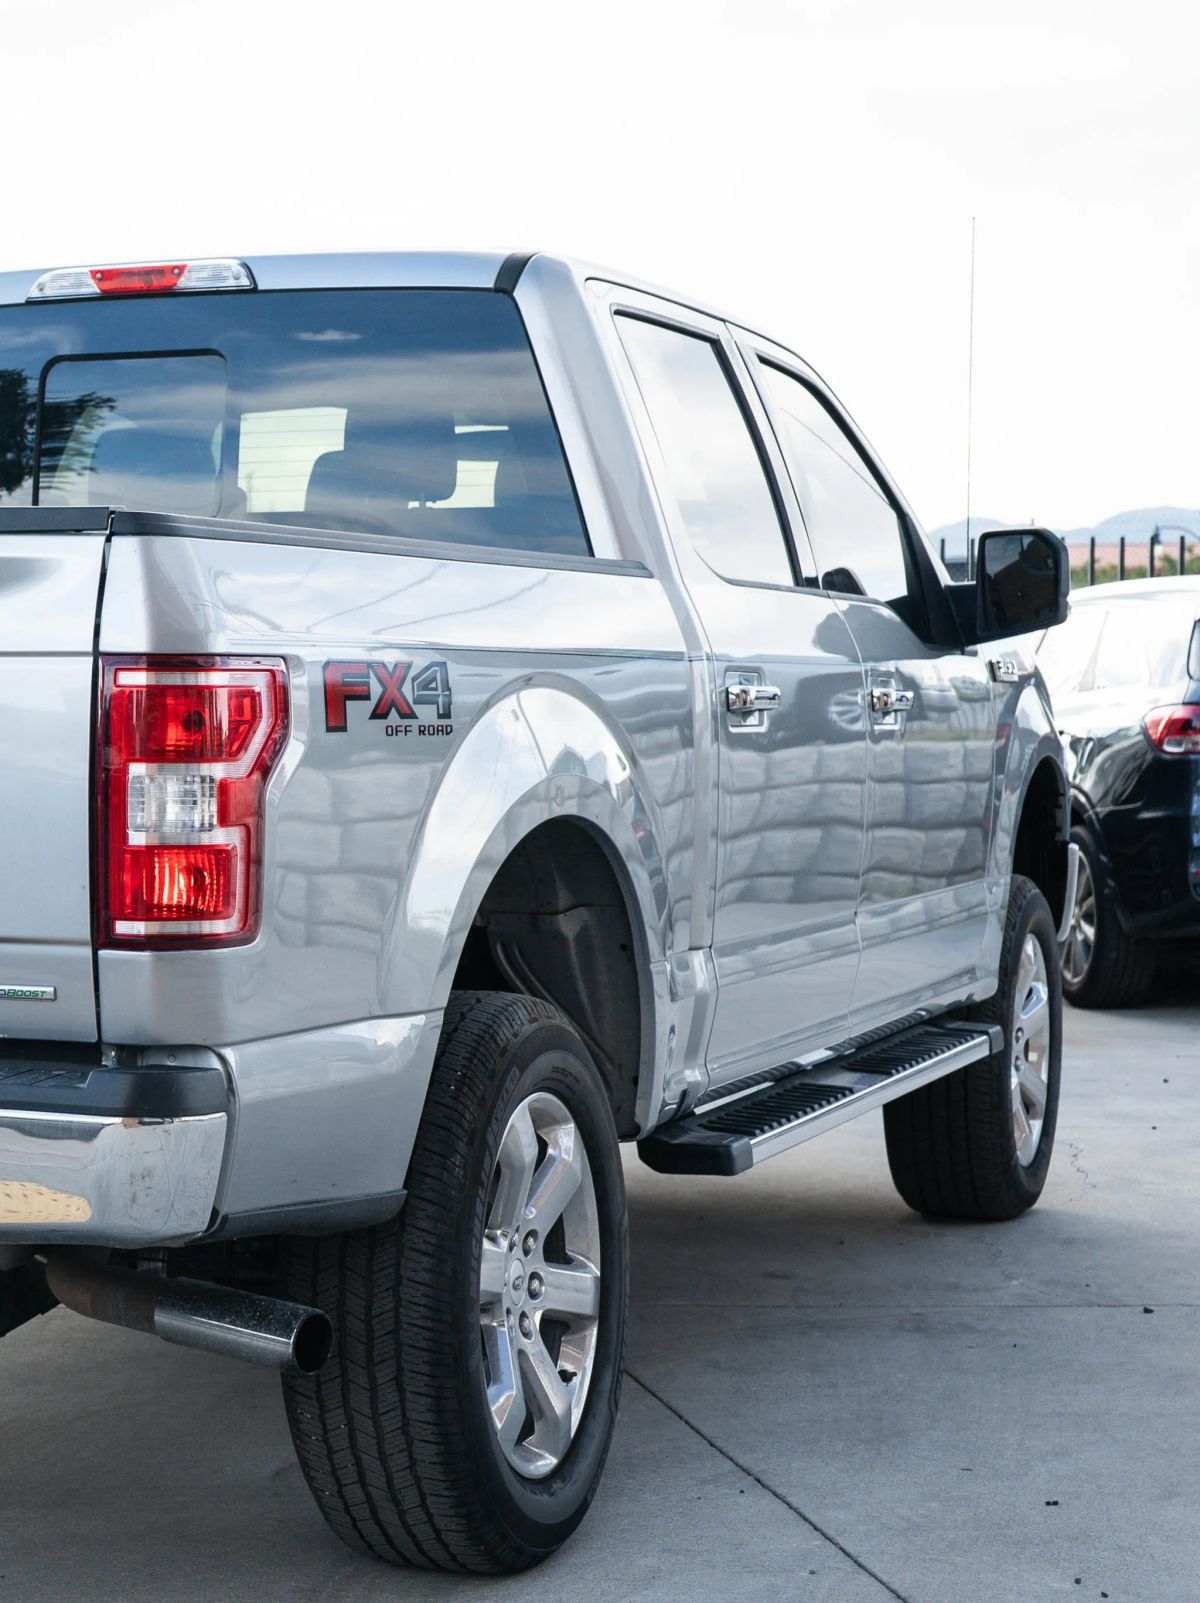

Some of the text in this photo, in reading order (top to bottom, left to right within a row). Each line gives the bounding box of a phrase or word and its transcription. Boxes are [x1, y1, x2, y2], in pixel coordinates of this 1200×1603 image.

[322, 660, 453, 733] FX4
[385, 723, 453, 737] OFF ROAD
